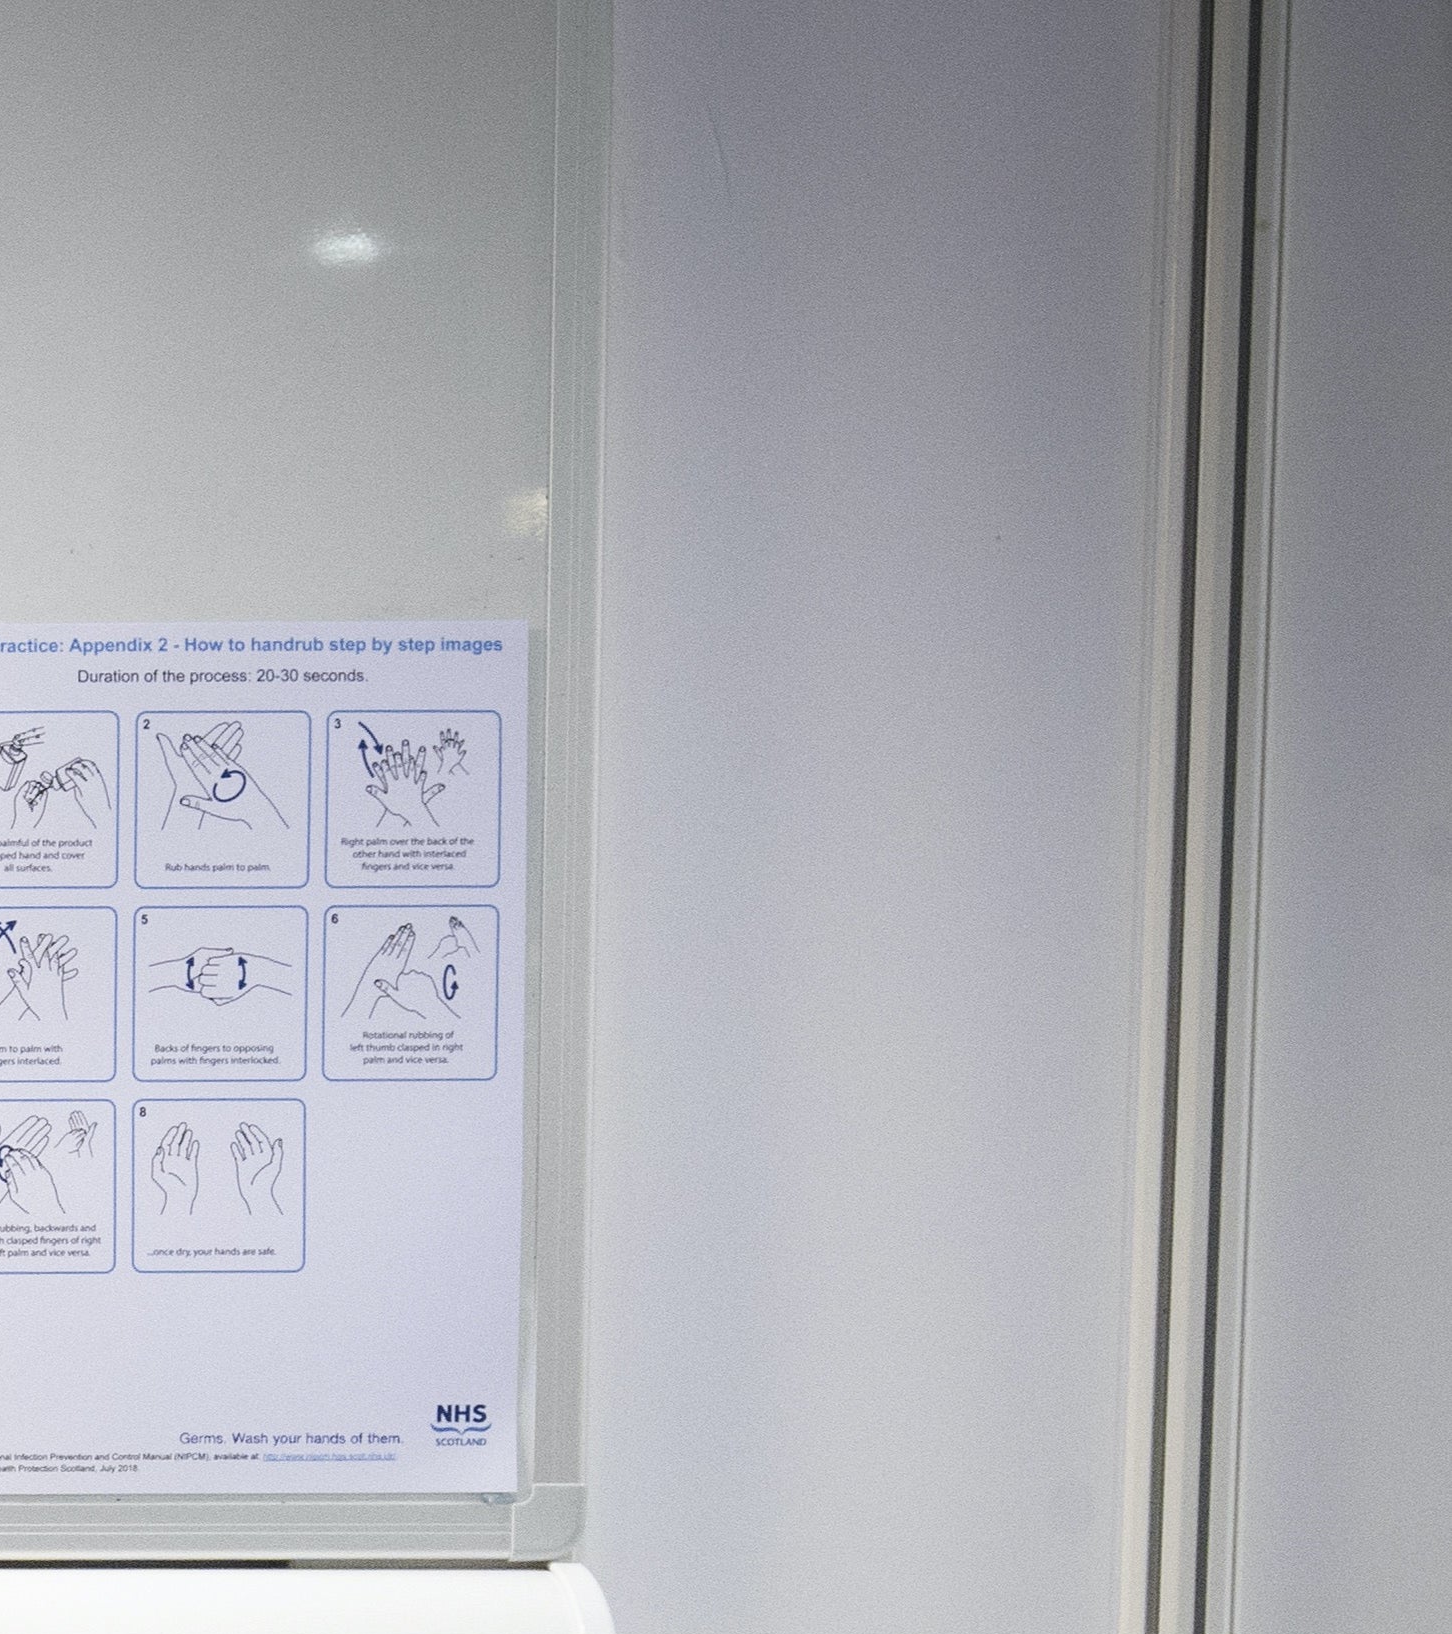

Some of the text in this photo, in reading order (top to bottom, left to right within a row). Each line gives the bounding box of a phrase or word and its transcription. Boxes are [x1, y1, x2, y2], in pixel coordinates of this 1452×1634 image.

[68, 637, 153, 657] Appendix
[157, 636, 168, 653] 2
[184, 637, 224, 653] How
[250, 636, 325, 653] handrub
[328, 637, 368, 656] step
[370, 636, 394, 657] by
[397, 636, 437, 656] step
[439, 635, 505, 657] images
[77, 667, 369, 686] Duration of the process: 20-30 seconds.
[142, 718, 151, 731] 2
[333, 717, 342, 730] 3
[30, 838, 41, 848] of
[41, 838, 57, 848] the
[57, 838, 94, 849] product
[18, 851, 42, 861] hand
[42, 850, 61, 861] and
[60, 852, 86, 861] cover
[3, 863, 15, 873] all
[164, 862, 184, 873] Rub
[183, 862, 211, 872] hands
[211, 862, 235, 873] palm
[140, 913, 149, 926] 5
[330, 912, 340, 925] 6
[19, 1044, 43, 1055] palm
[43, 1044, 64, 1053] with
[138, 1105, 147, 1118] 8
[192, 1248, 213, 1258] your
[213, 1247, 241, 1257] hands
[241, 1248, 257, 1257] are
[436, 1403, 488, 1424] NHS
[178, 1431, 402, 1447] Germs. Wash your hands of them.
[435, 1437, 488, 1447] SCOTLAND
